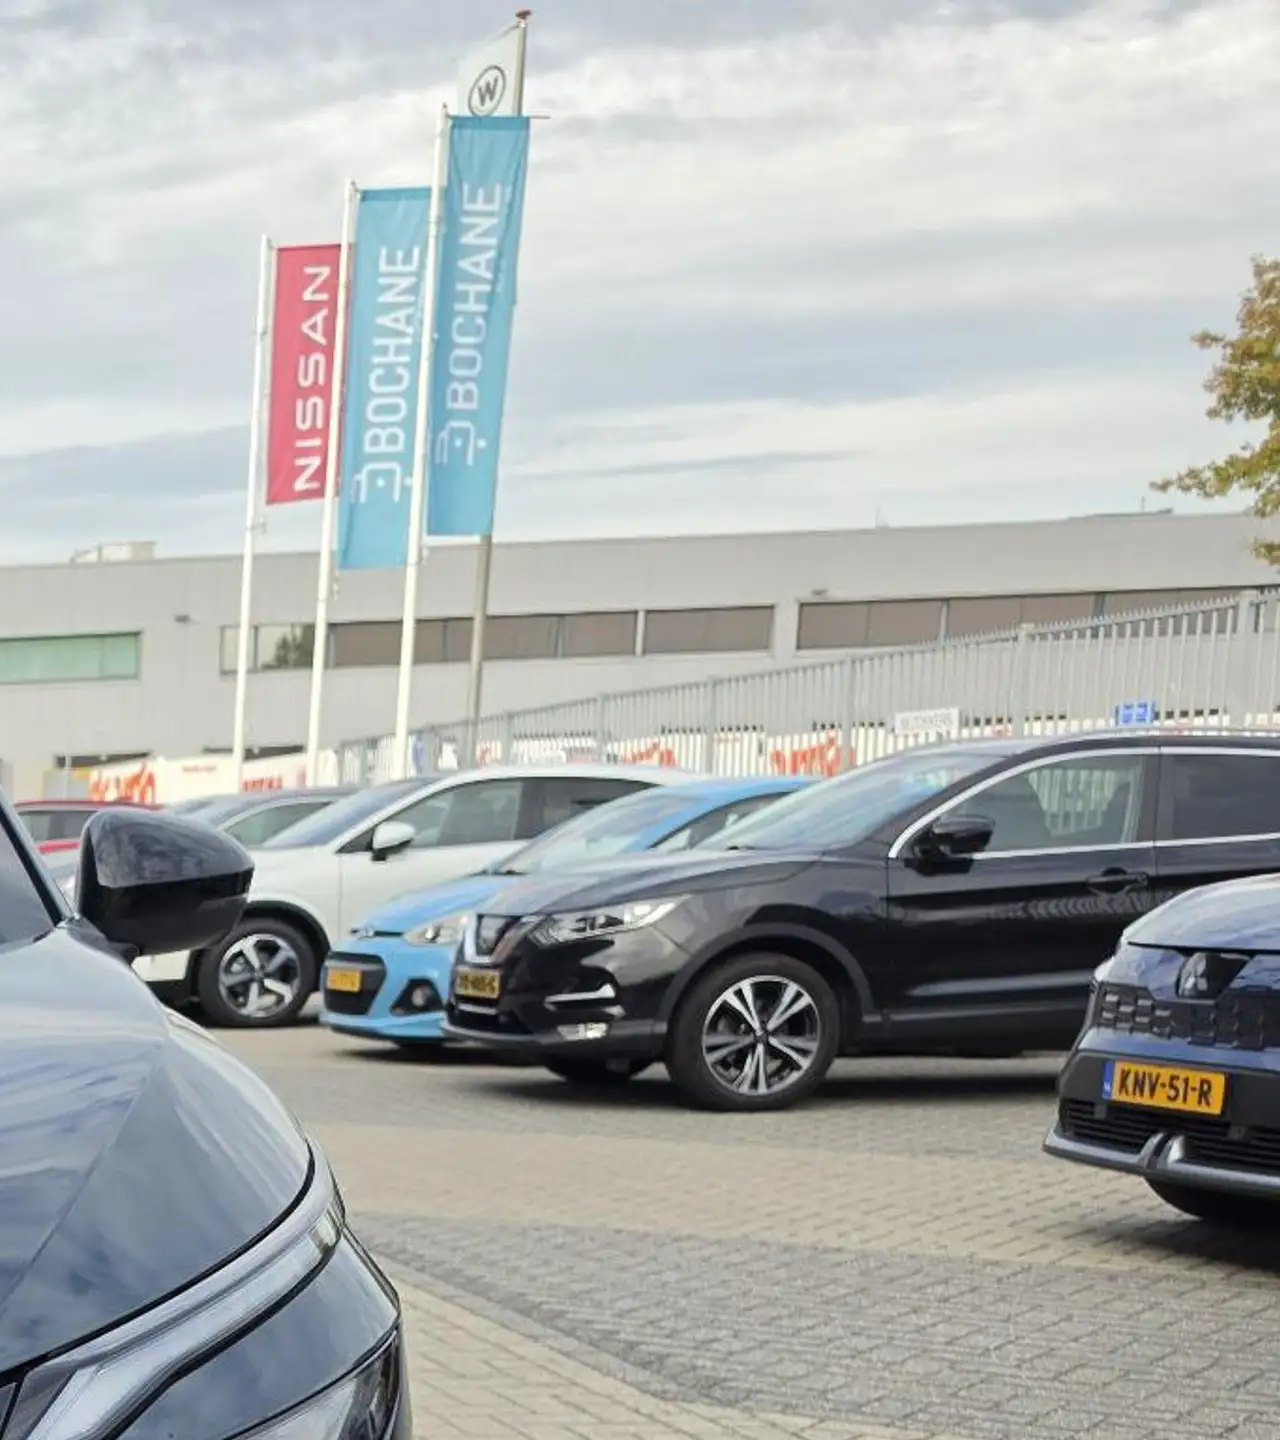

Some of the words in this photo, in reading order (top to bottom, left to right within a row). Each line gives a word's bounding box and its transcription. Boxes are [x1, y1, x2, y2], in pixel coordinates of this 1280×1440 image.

[292, 264, 332, 493] NISSAN
[363, 245, 421, 454] BOCHANE
[445, 181, 502, 411] BOCHANE
[1118, 1067, 1213, 1108] KNV-51-R
